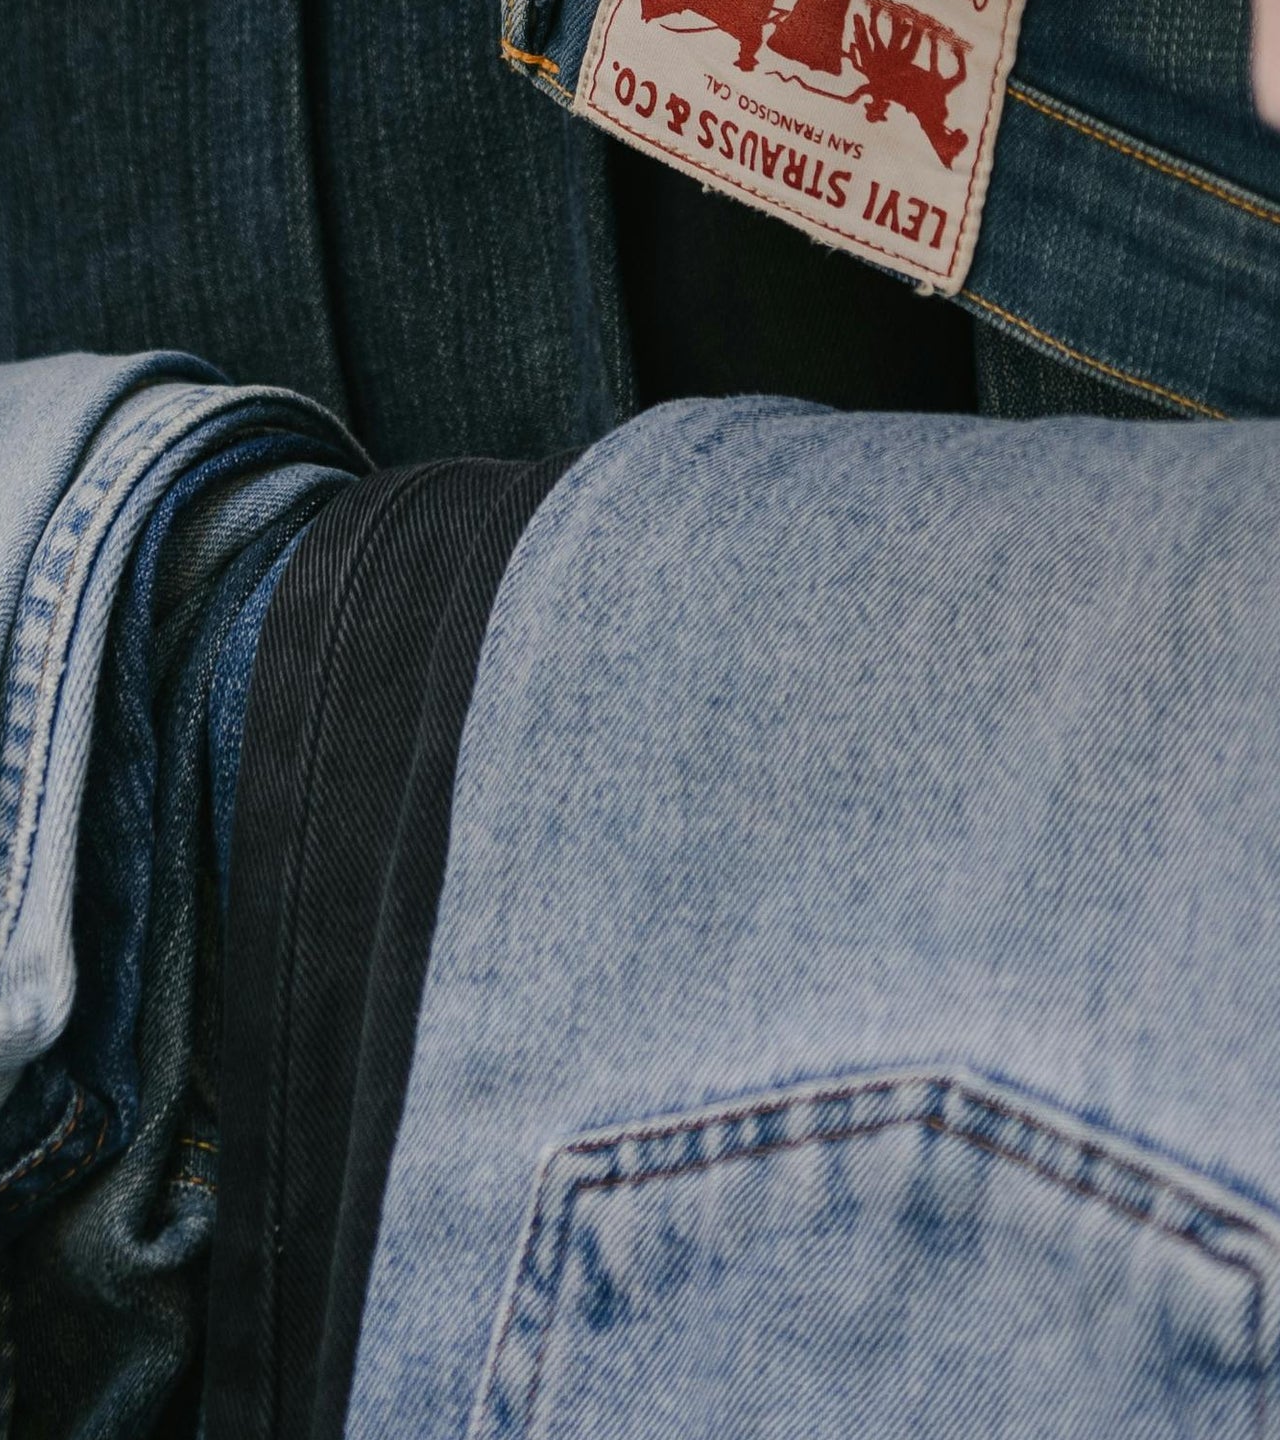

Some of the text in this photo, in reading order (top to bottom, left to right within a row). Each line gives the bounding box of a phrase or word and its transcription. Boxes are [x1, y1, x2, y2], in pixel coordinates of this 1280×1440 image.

[703, 72, 731, 100] CAL.
[612, 60, 948, 250] LEVI STRAUSS & CO.
[828, 132, 864, 160] SAN
